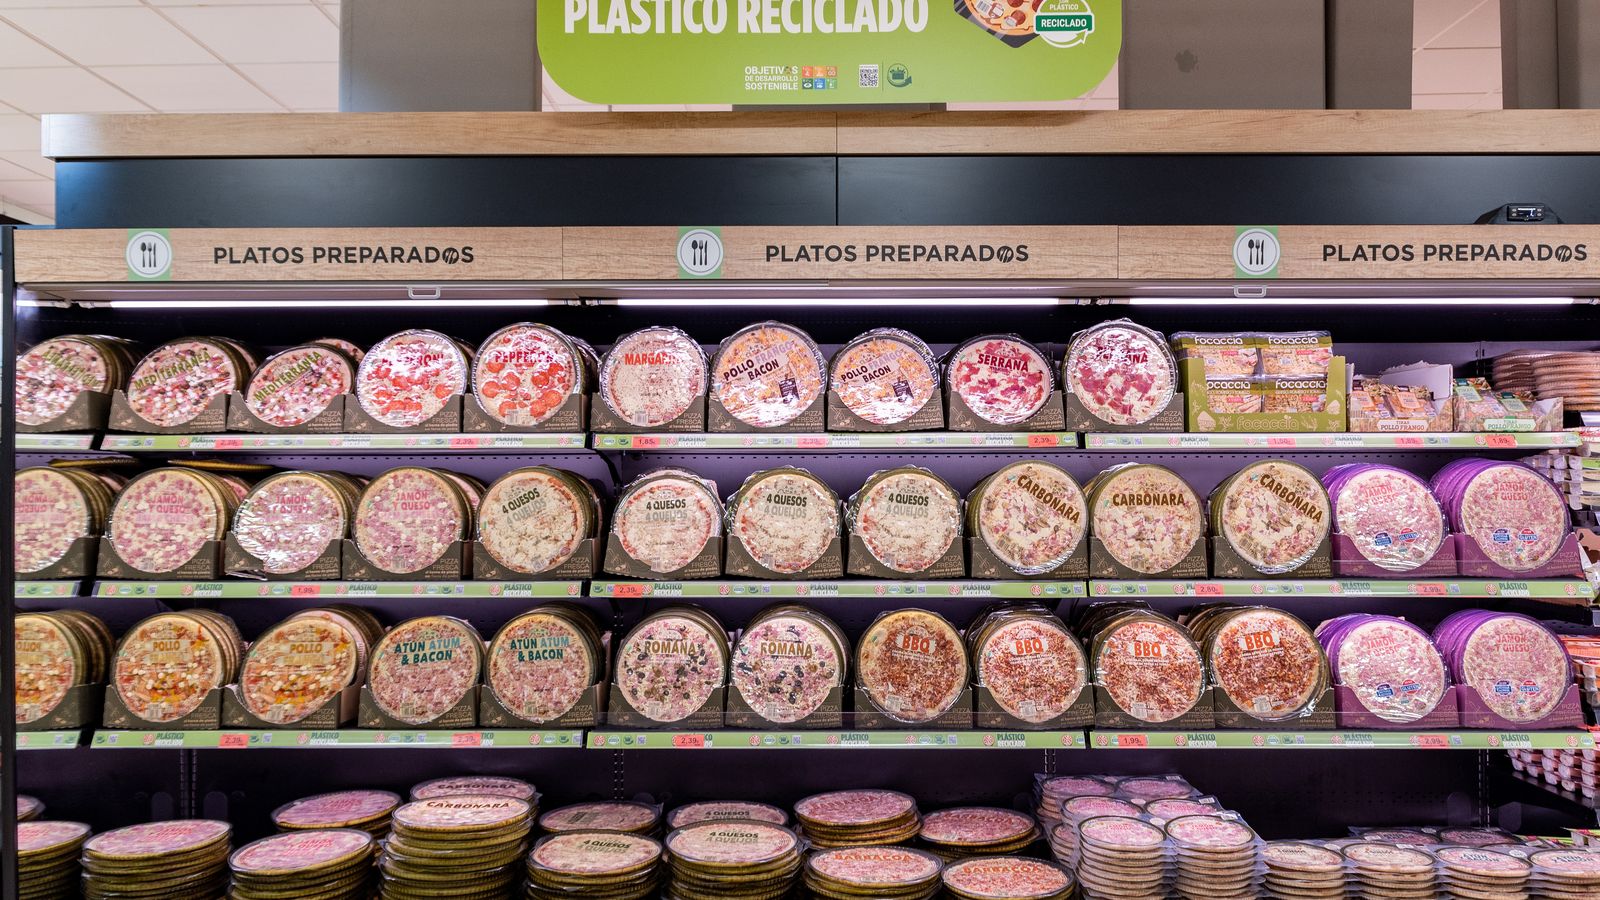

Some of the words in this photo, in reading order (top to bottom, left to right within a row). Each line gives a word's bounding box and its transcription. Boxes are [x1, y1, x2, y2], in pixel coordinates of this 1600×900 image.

[738, 0, 929, 34] RECICLADO
[1041, 18, 1087, 28] RECICLADO
[744, 82, 798, 90] SOSTENIBLE
[214, 246, 304, 265] PLATOS
[313, 246, 475, 265] PREPARADOS
[766, 244, 857, 263] PLATOS
[866, 244, 1030, 263] PREPARADOS
[1322, 244, 1415, 262] PLATOS
[1424, 244, 1588, 262] PREPARADOS
[1194, 336, 1243, 345] focaccia
[1268, 336, 1318, 345] focaccia
[134, 351, 211, 389] MEDITERRANEA
[723, 359, 755, 382] POLLO
[747, 358, 780, 381] BACON
[977, 353, 1029, 373] SERRANA
[253, 351, 322, 402] MEDITERRANEA
[840, 364, 869, 383] POLLO
[861, 364, 892, 384] BACON
[1206, 380, 1250, 390] ocaccia
[1275, 379, 1326, 389] focaccia
[1236, 415, 1299, 431] focaccia
[402, 500, 430, 510] QUESO
[502, 506, 509, 514] 4
[508, 488, 540, 512] QUESOS
[646, 501, 652, 510] 4
[653, 499, 687, 510] QUESOS
[766, 494, 772, 504] 4
[774, 494, 808, 508] QUESOS
[888, 493, 894, 503] 4
[896, 494, 930, 506] QUESOS
[1017, 474, 1080, 524] CARBONARA
[1112, 493, 1186, 507] CARBONARA
[1260, 474, 1322, 523] CARBONARA
[153, 641, 180, 652] POLLO
[429, 637, 460, 650] ATUM
[540, 636, 570, 648] ATUM
[902, 635, 930, 653] BBQ
[1016, 638, 1044, 655] BBQ
[1244, 631, 1276, 649] BBQ
[290, 643, 322, 654] POLLO
[518, 652, 526, 662] &
[528, 649, 563, 661] BACON
[645, 641, 696, 655] ROMANA
[761, 641, 813, 657] ROMANA
[1134, 642, 1161, 658] BBQ
[401, 654, 409, 665] &
[414, 650, 453, 664] BACON
[426, 801, 510, 810] CARBONARA
[591, 840, 633, 849] QUESOS
[962, 865, 1042, 874] BARBACOA
